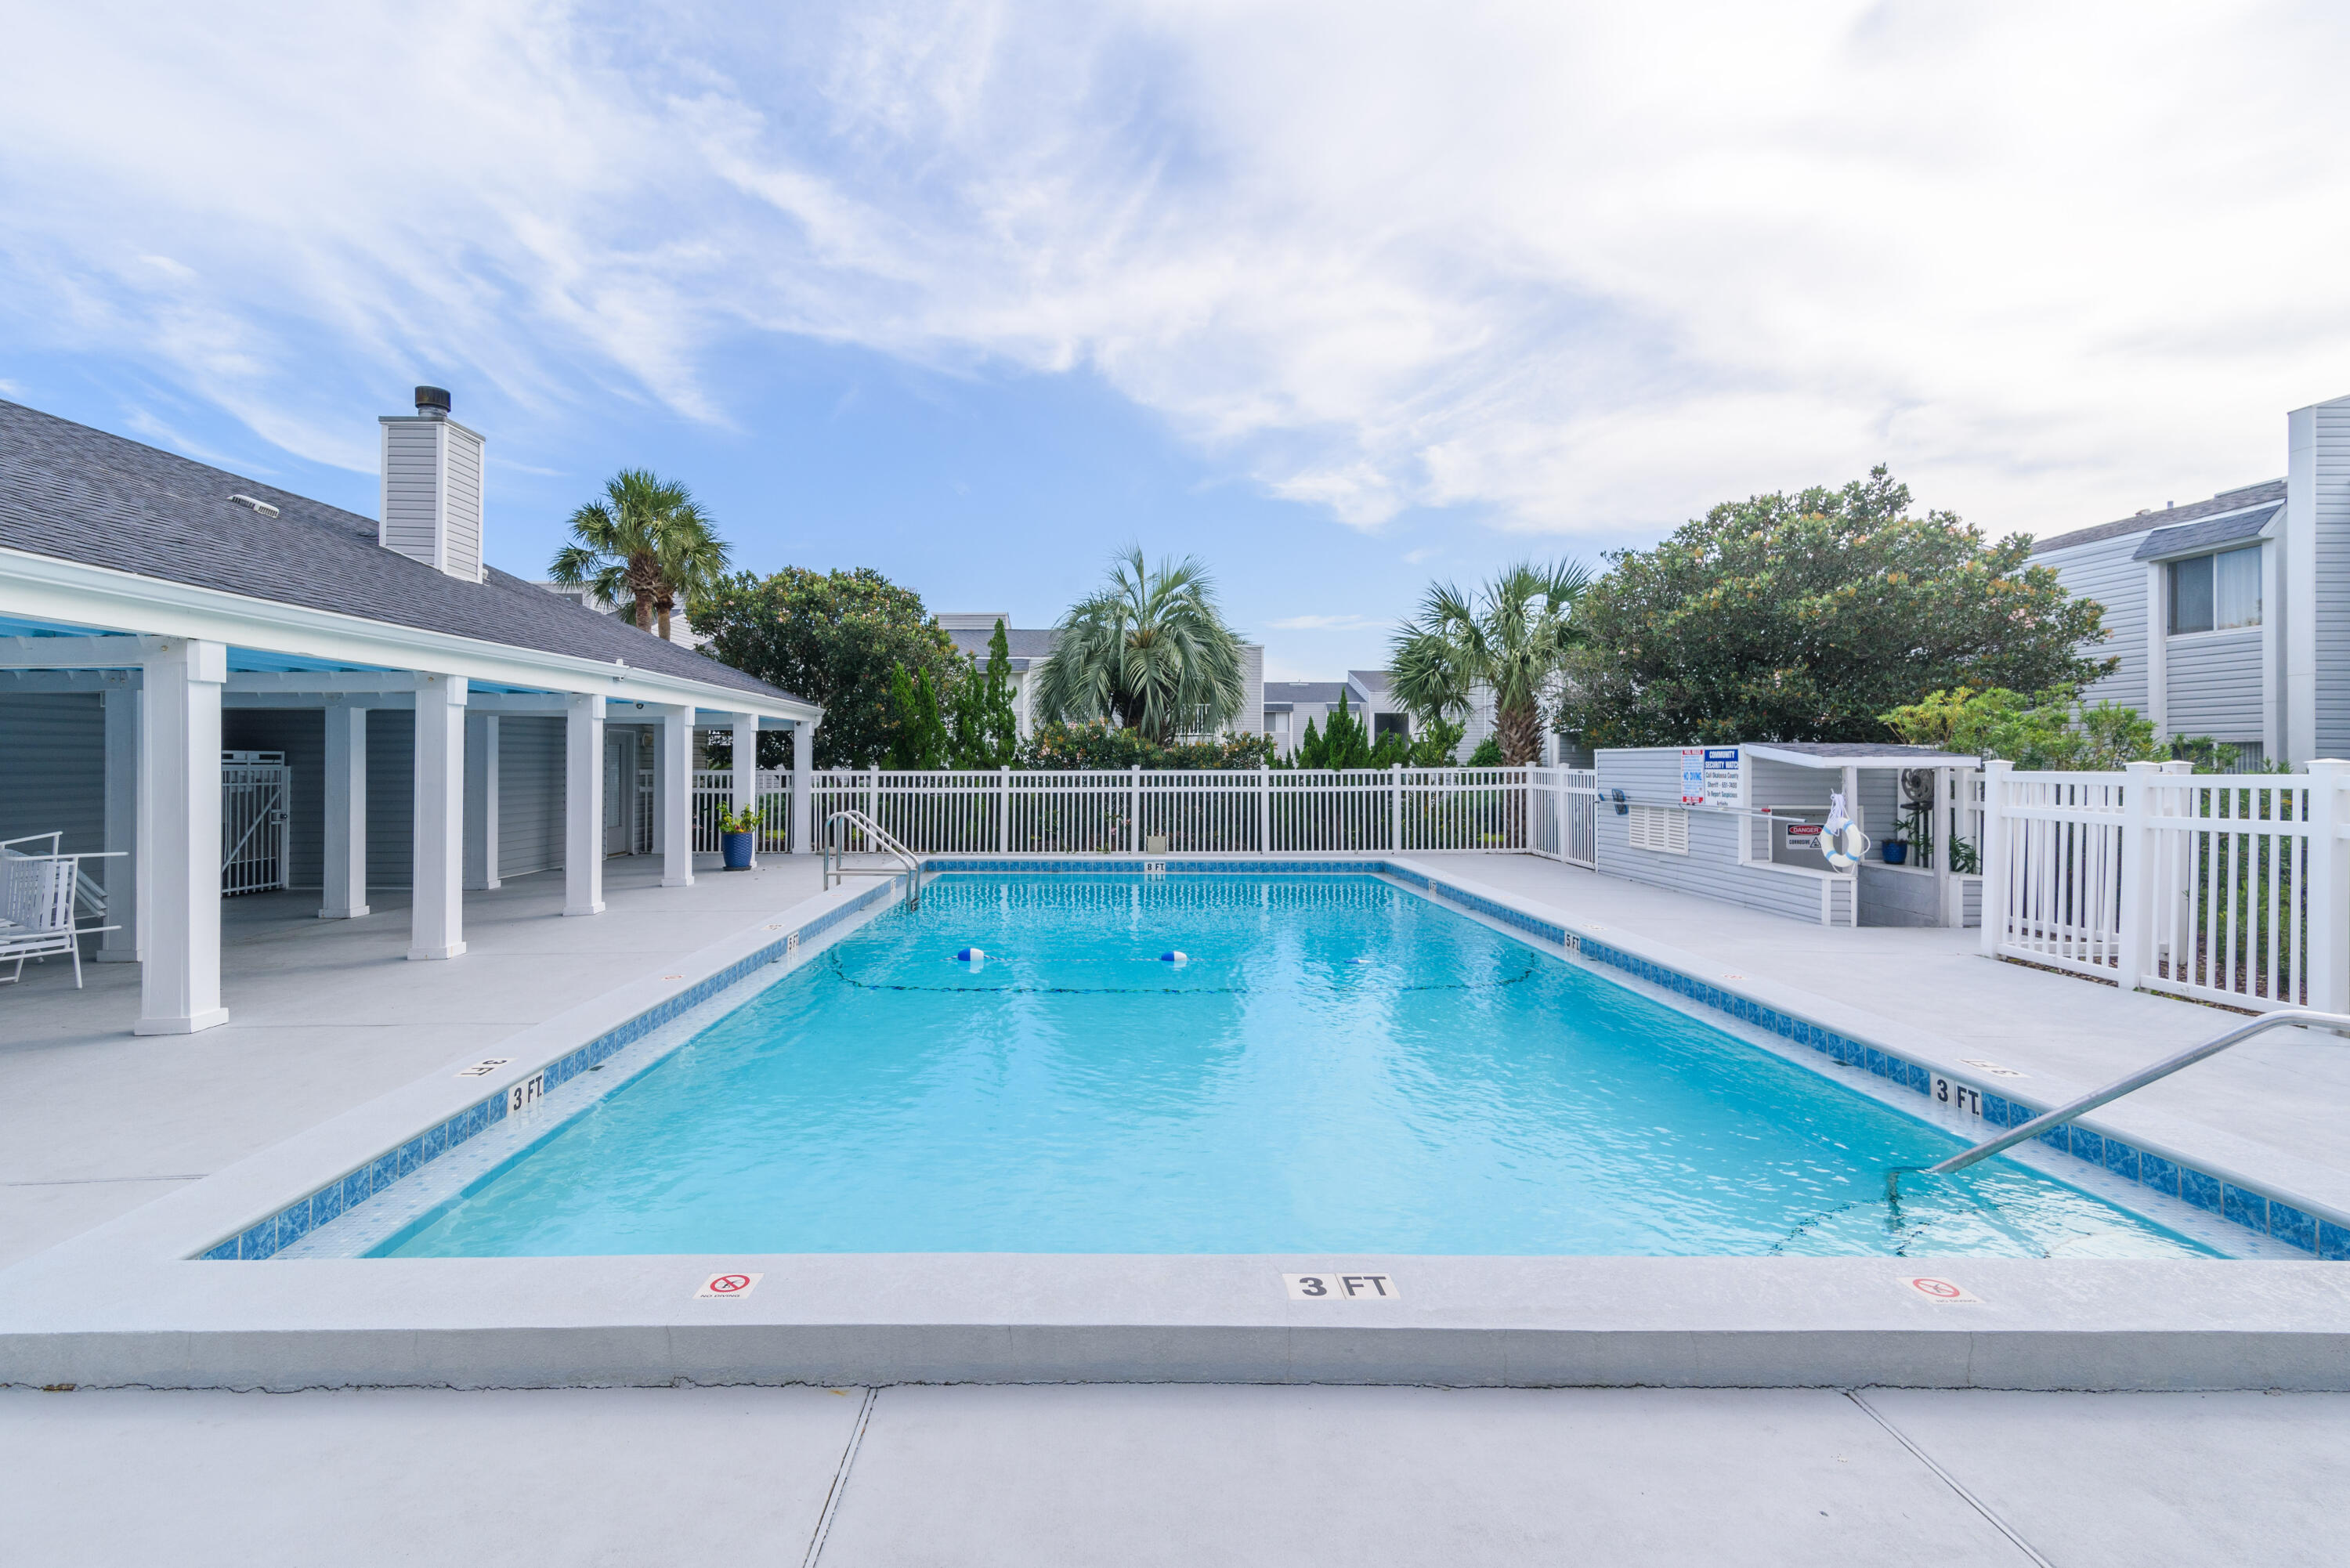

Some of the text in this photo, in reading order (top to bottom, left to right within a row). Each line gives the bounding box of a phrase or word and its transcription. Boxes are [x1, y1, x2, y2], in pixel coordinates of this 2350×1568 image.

[1709, 750, 1735, 759] COMMUNITY
[1705, 761, 1724, 769] SECURITY
[789, 938, 792, 951] 5
[1567, 934, 1571, 947] 5
[513, 1087, 522, 1111] 3
[1936, 1078, 1980, 1116] 3 FT.
[1299, 1276, 1387, 1296] 3 FT
